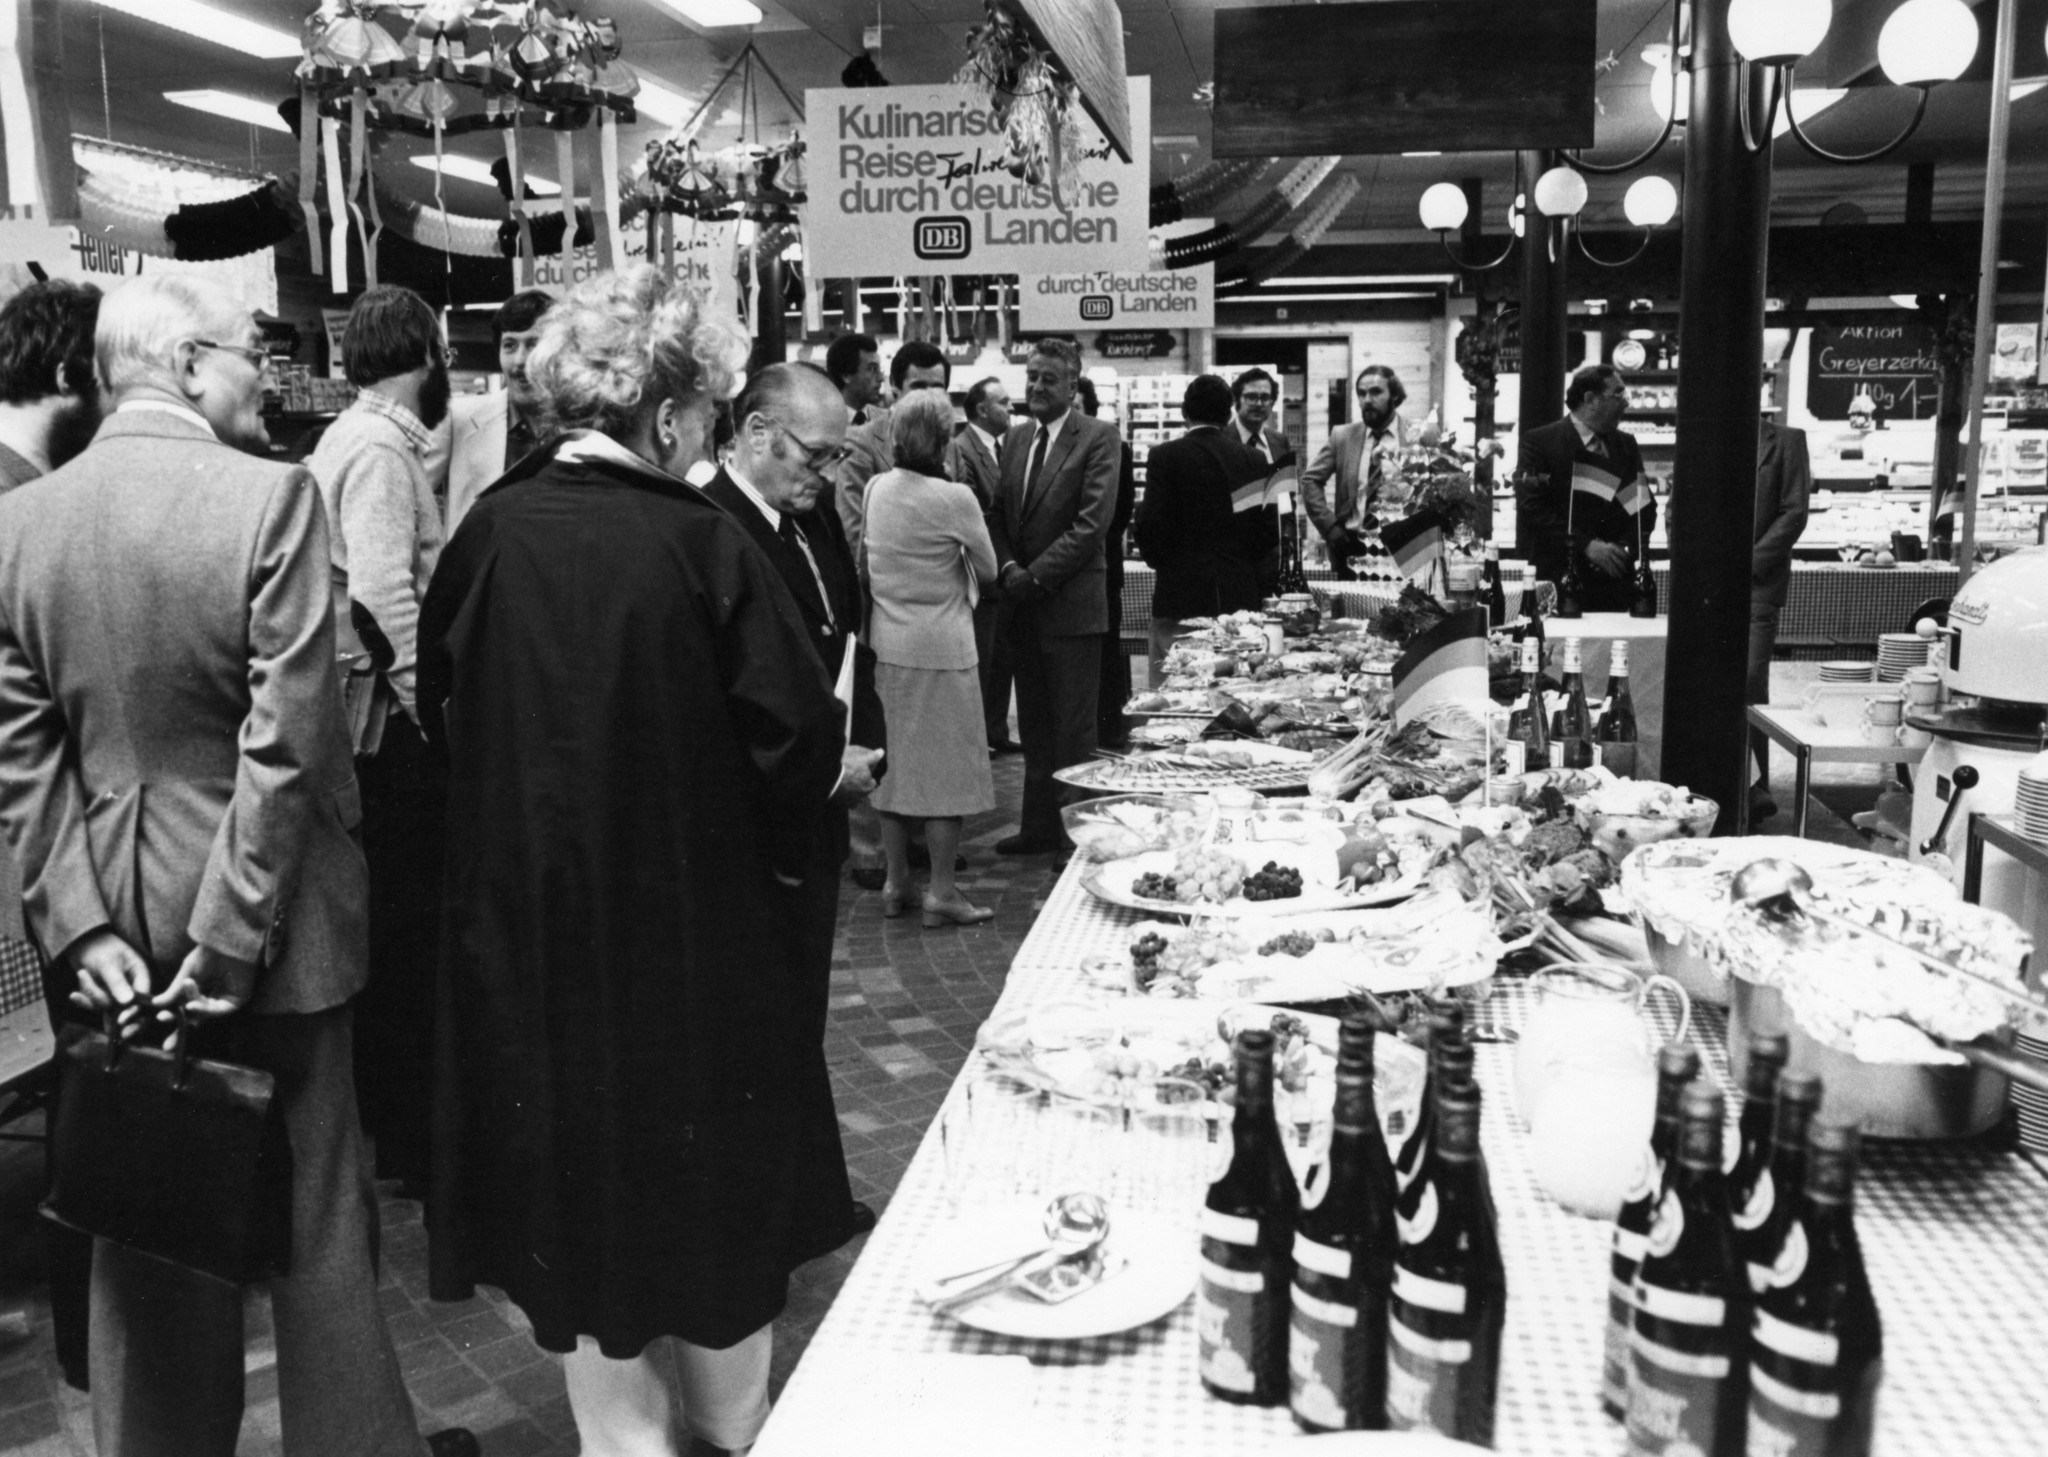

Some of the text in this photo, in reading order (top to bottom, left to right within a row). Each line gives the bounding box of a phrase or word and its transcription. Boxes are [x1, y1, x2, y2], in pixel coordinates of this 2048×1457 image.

[839, 101, 1003, 139] Kulinarisc
[839, 143, 937, 179] Reise
[839, 176, 1120, 214] durch deutse
[984, 211, 1118, 245] Landen
[535, 259, 599, 286] duch
[1037, 272, 1198, 295] durch deutsche
[1120, 292, 1197, 312] Landen
